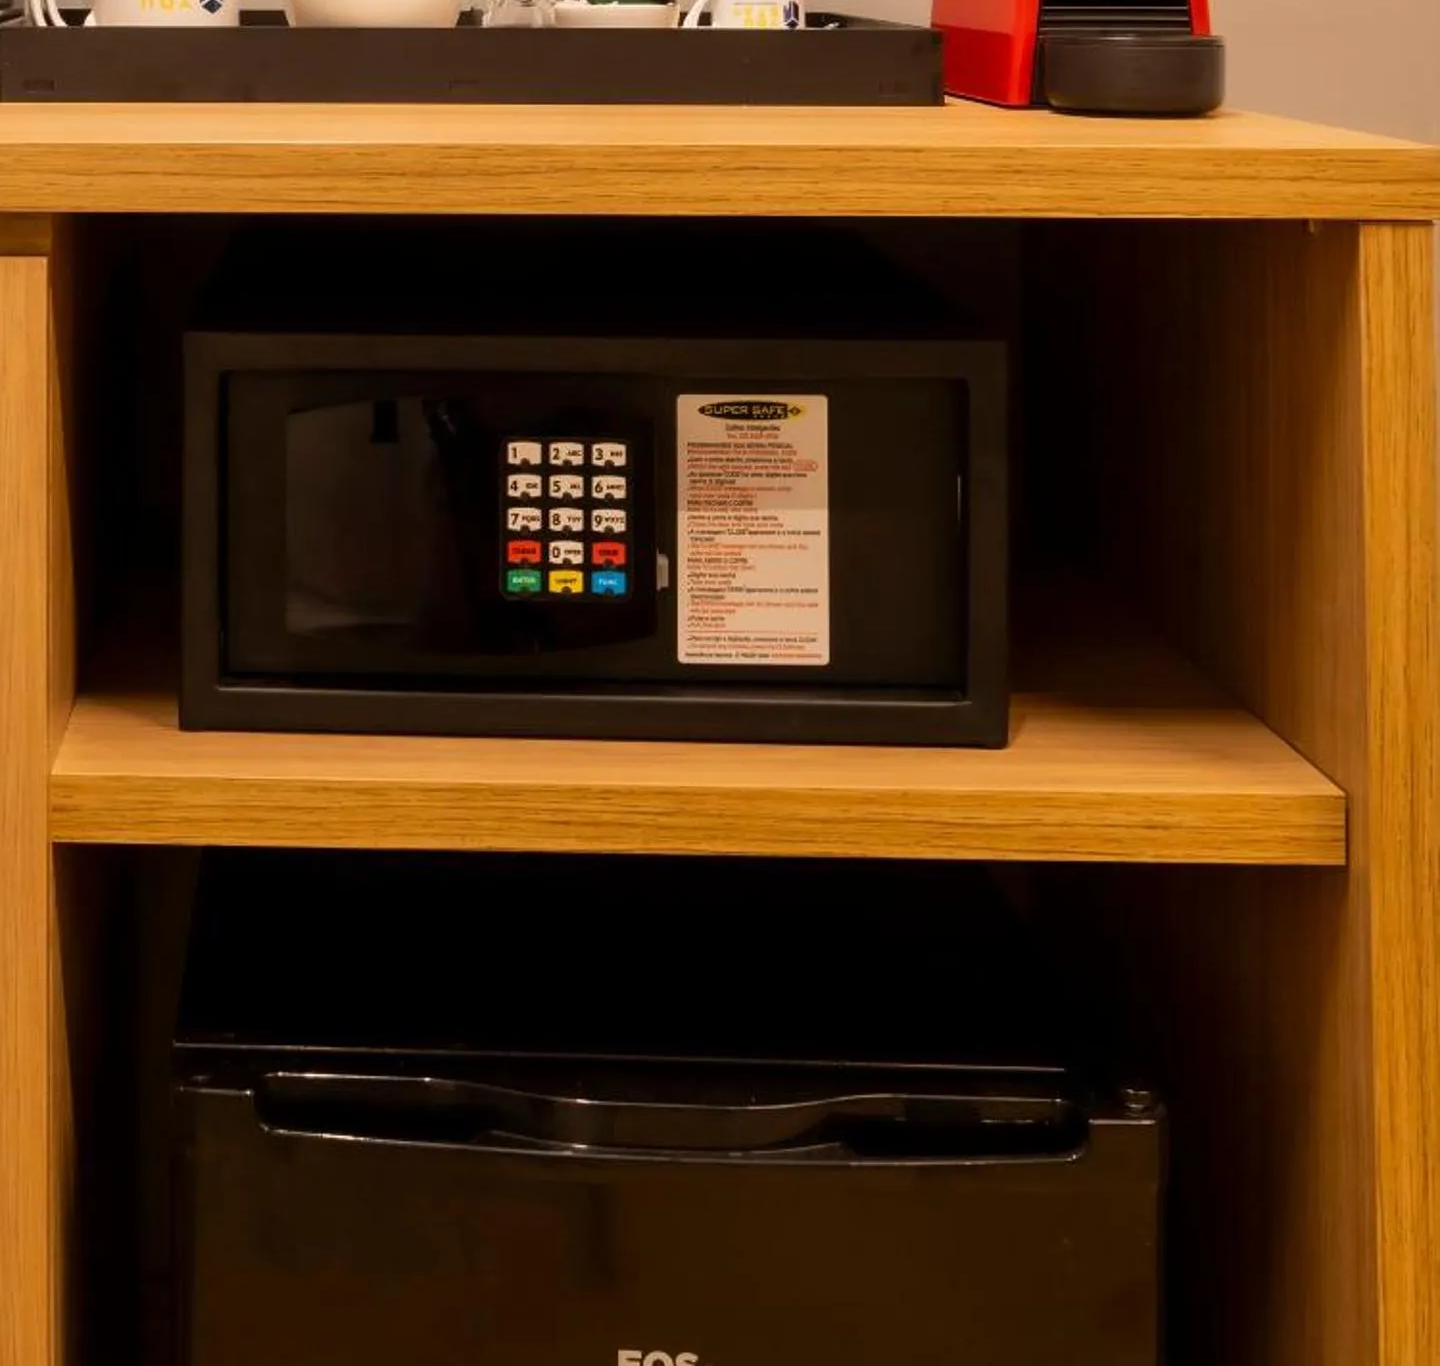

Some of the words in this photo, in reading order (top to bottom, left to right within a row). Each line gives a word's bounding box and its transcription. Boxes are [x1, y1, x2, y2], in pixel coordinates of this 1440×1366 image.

[511, 447, 518, 459] 1
[552, 447, 561, 460] 2
[595, 448, 604, 460] 3
[510, 480, 519, 491] 4
[552, 481, 561, 493] 5
[594, 481, 603, 493] 6
[510, 513, 519, 525] 7
[552, 513, 561, 526] 8
[594, 515, 603, 527] 9
[552, 546, 561, 558] 0
